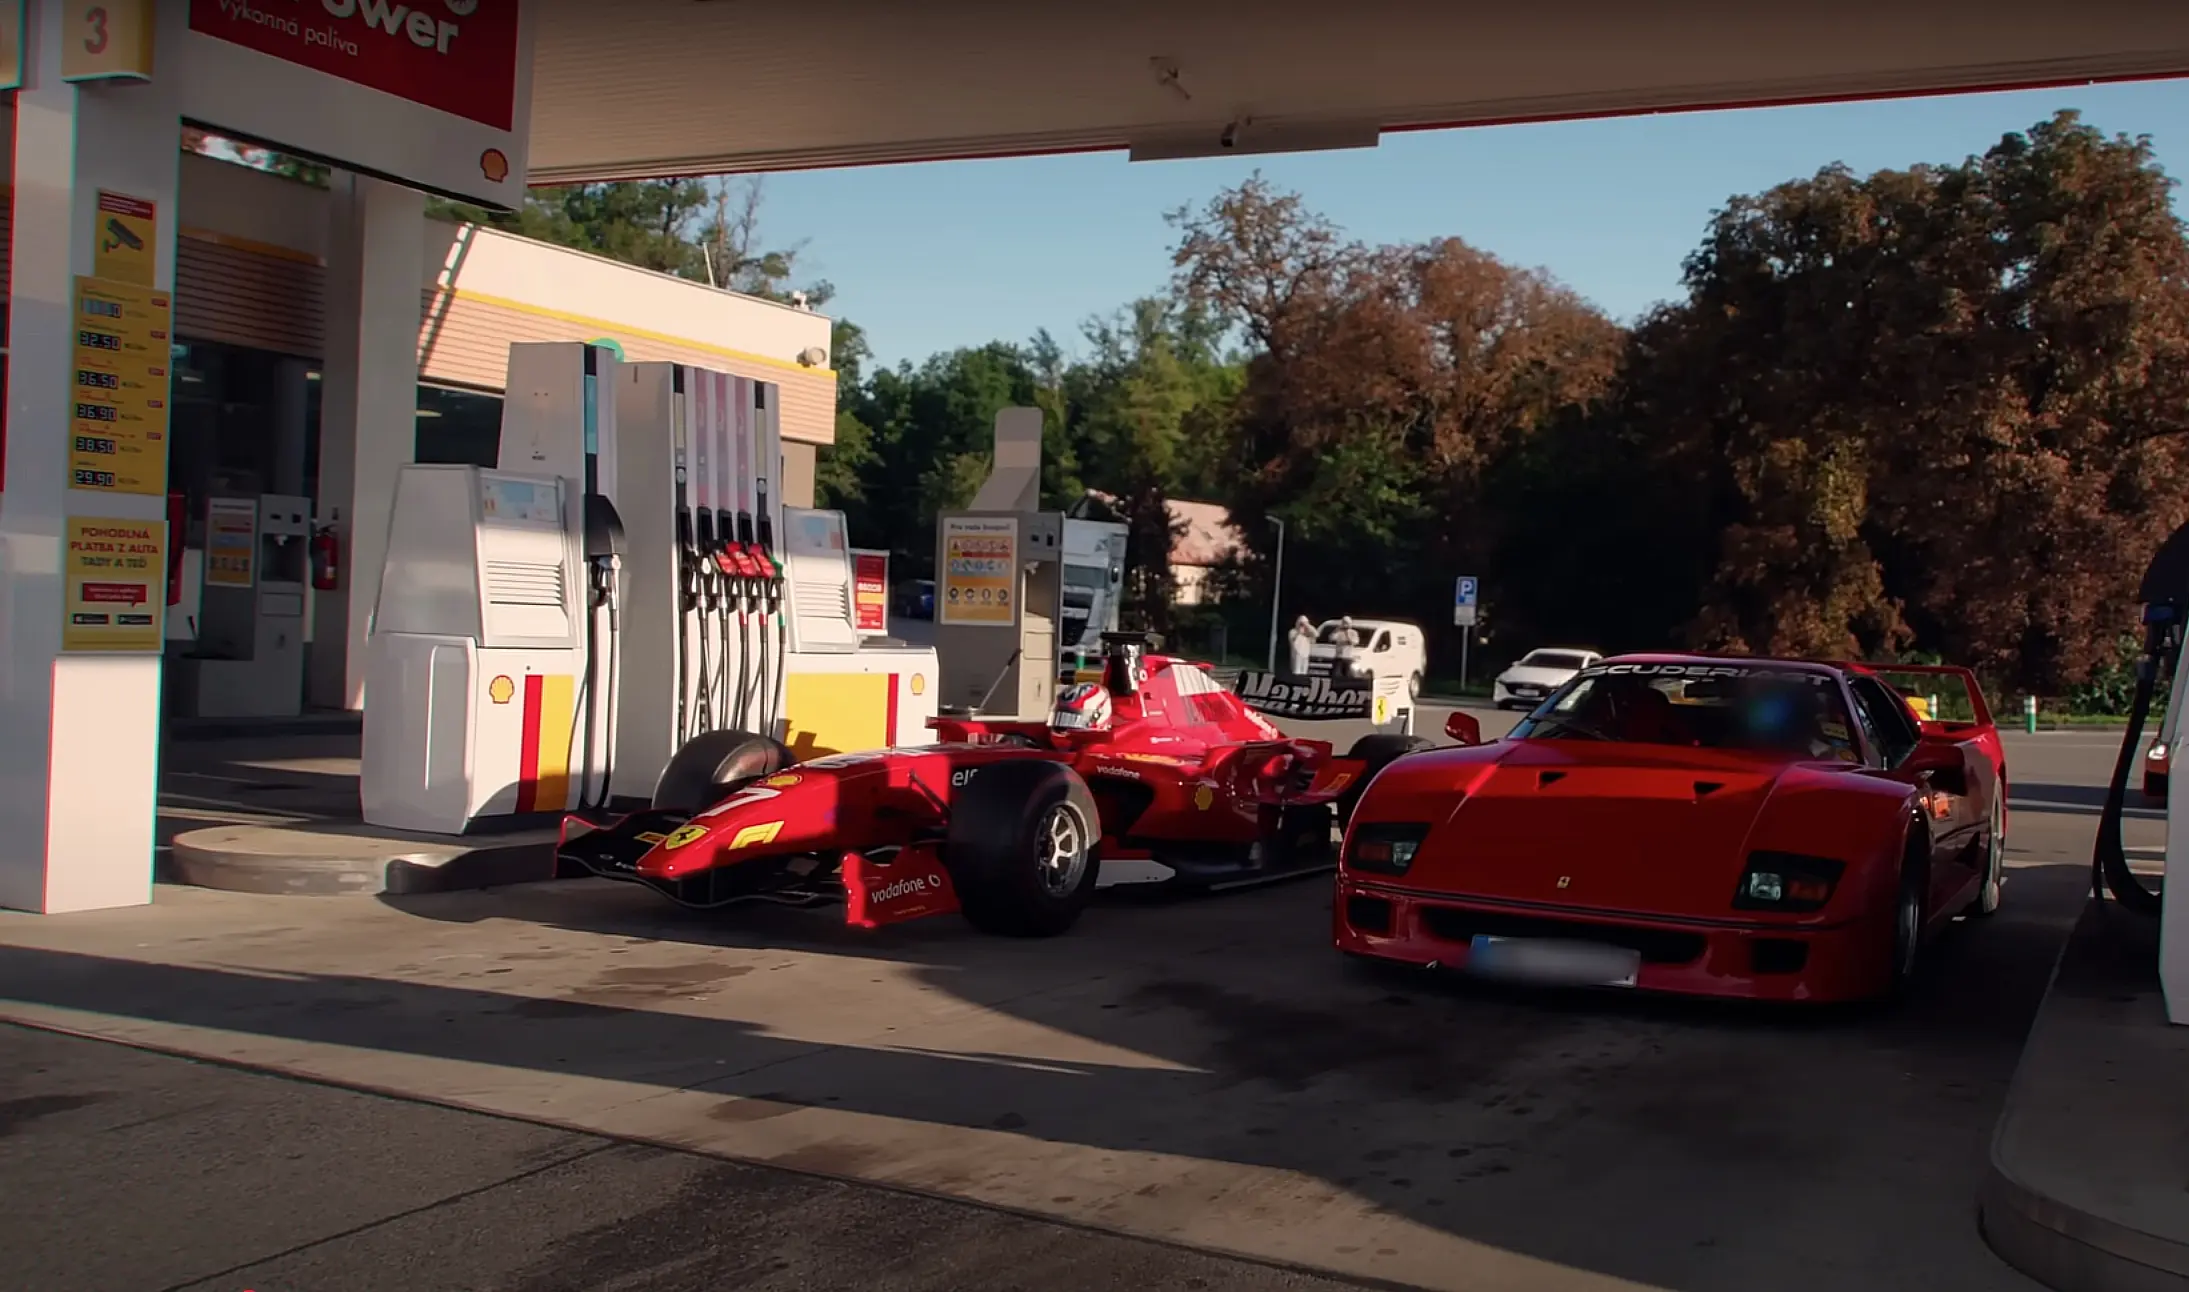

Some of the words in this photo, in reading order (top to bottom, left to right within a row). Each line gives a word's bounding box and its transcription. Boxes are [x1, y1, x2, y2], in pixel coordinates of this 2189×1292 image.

[84, 7, 108, 54] 3
[304, 26, 358, 56] paliva
[322, 0, 458, 54] ower
[128, 544, 158, 554] AUTA
[1460, 580, 1473, 596] P
[1242, 671, 1371, 711] Marlbor
[1096, 765, 1140, 780] vodafone
[698, 787, 782, 817] 7
[871, 877, 926, 904] vodafone
